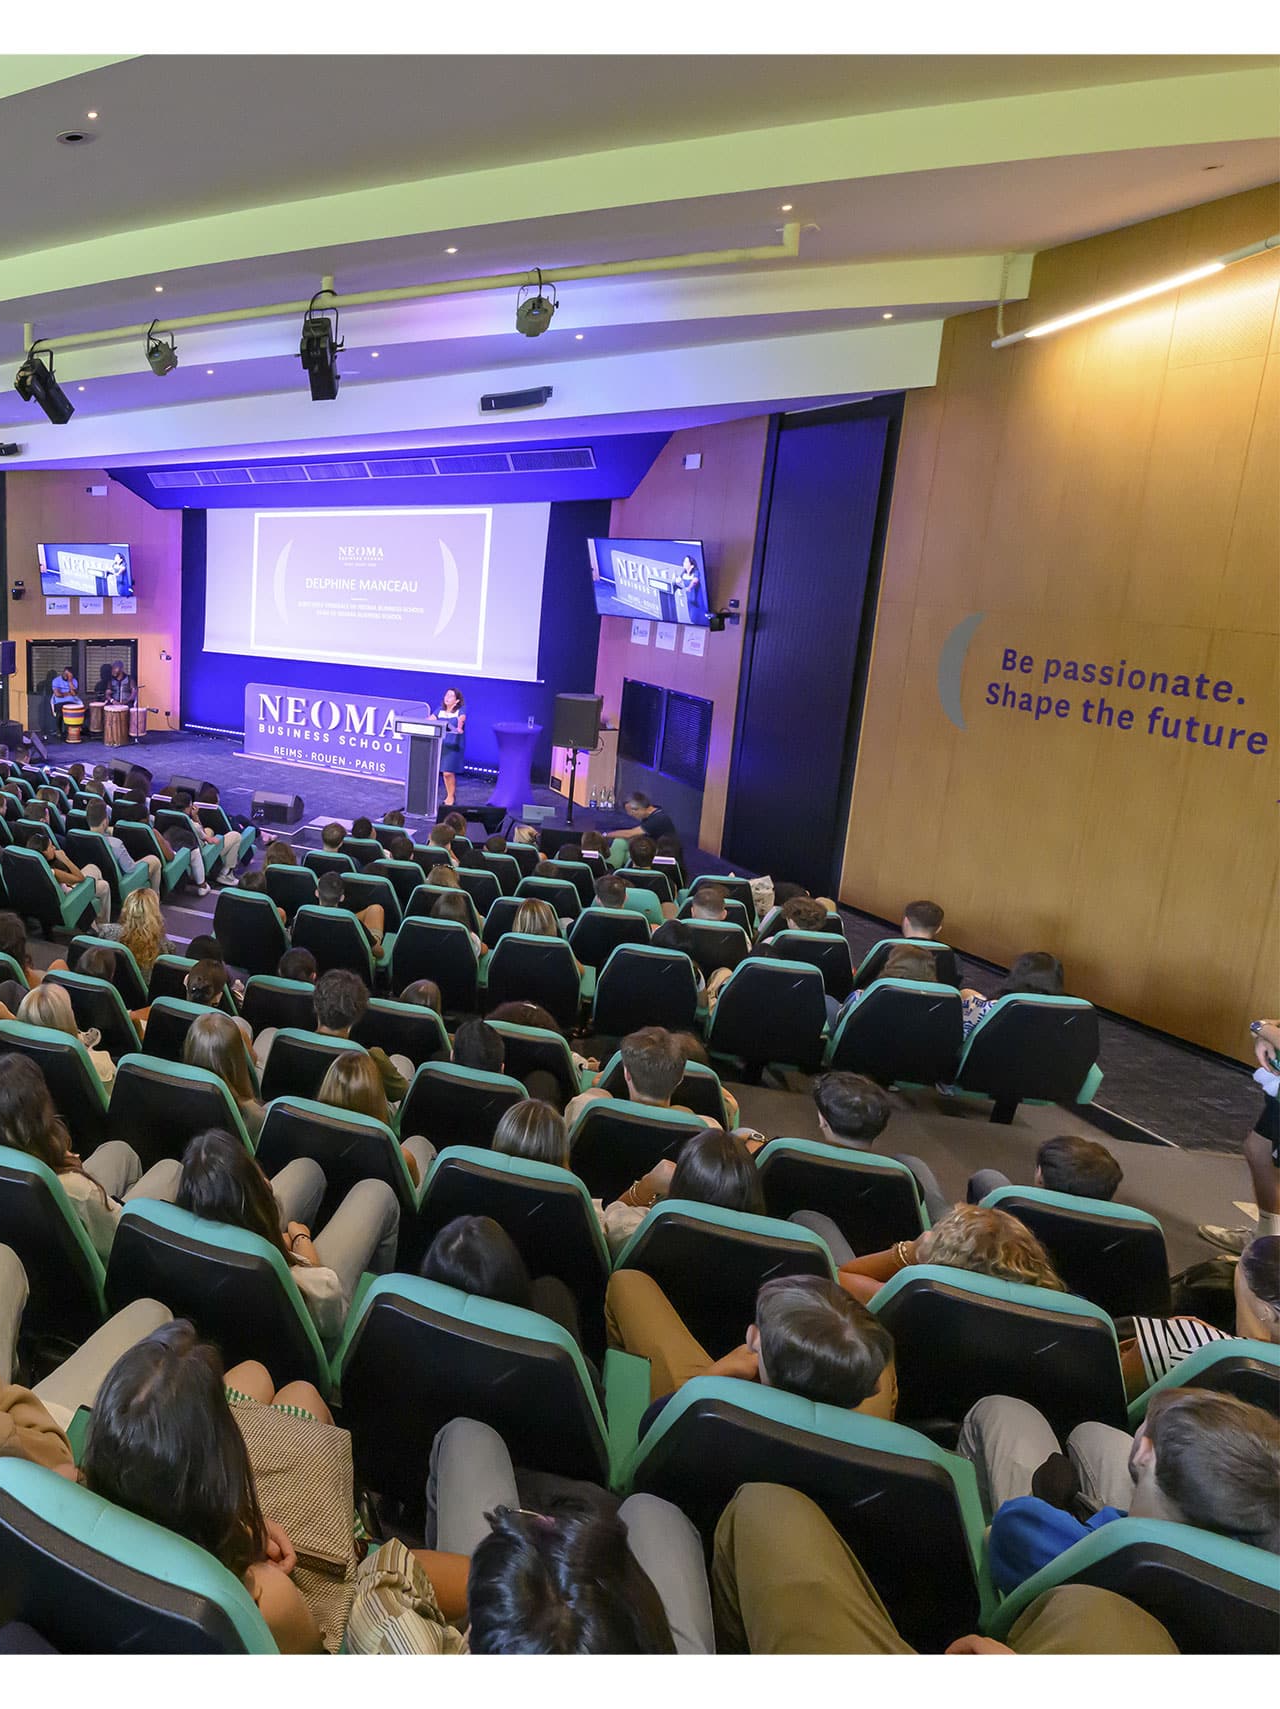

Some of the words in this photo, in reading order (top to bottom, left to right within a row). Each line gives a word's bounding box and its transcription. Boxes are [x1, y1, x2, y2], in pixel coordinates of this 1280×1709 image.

[338, 546, 384, 557] NEOMA
[305, 577, 356, 590] DELPHINE
[359, 579, 418, 592] MANCEAU
[1001, 648, 1034, 674] Be
[1043, 659, 1245, 705] passionate.
[258, 693, 404, 740] NEOMA
[985, 682, 1070, 720] Shape
[1082, 698, 1134, 730] the
[1148, 706, 1268, 755] future
[258, 724, 330, 743] BUSINESS
[339, 735, 403, 754] SCHOOL
[274, 746, 303, 759] REIMS
[311, 752, 346, 766] ROUEN
[355, 759, 386, 773] PARIS
